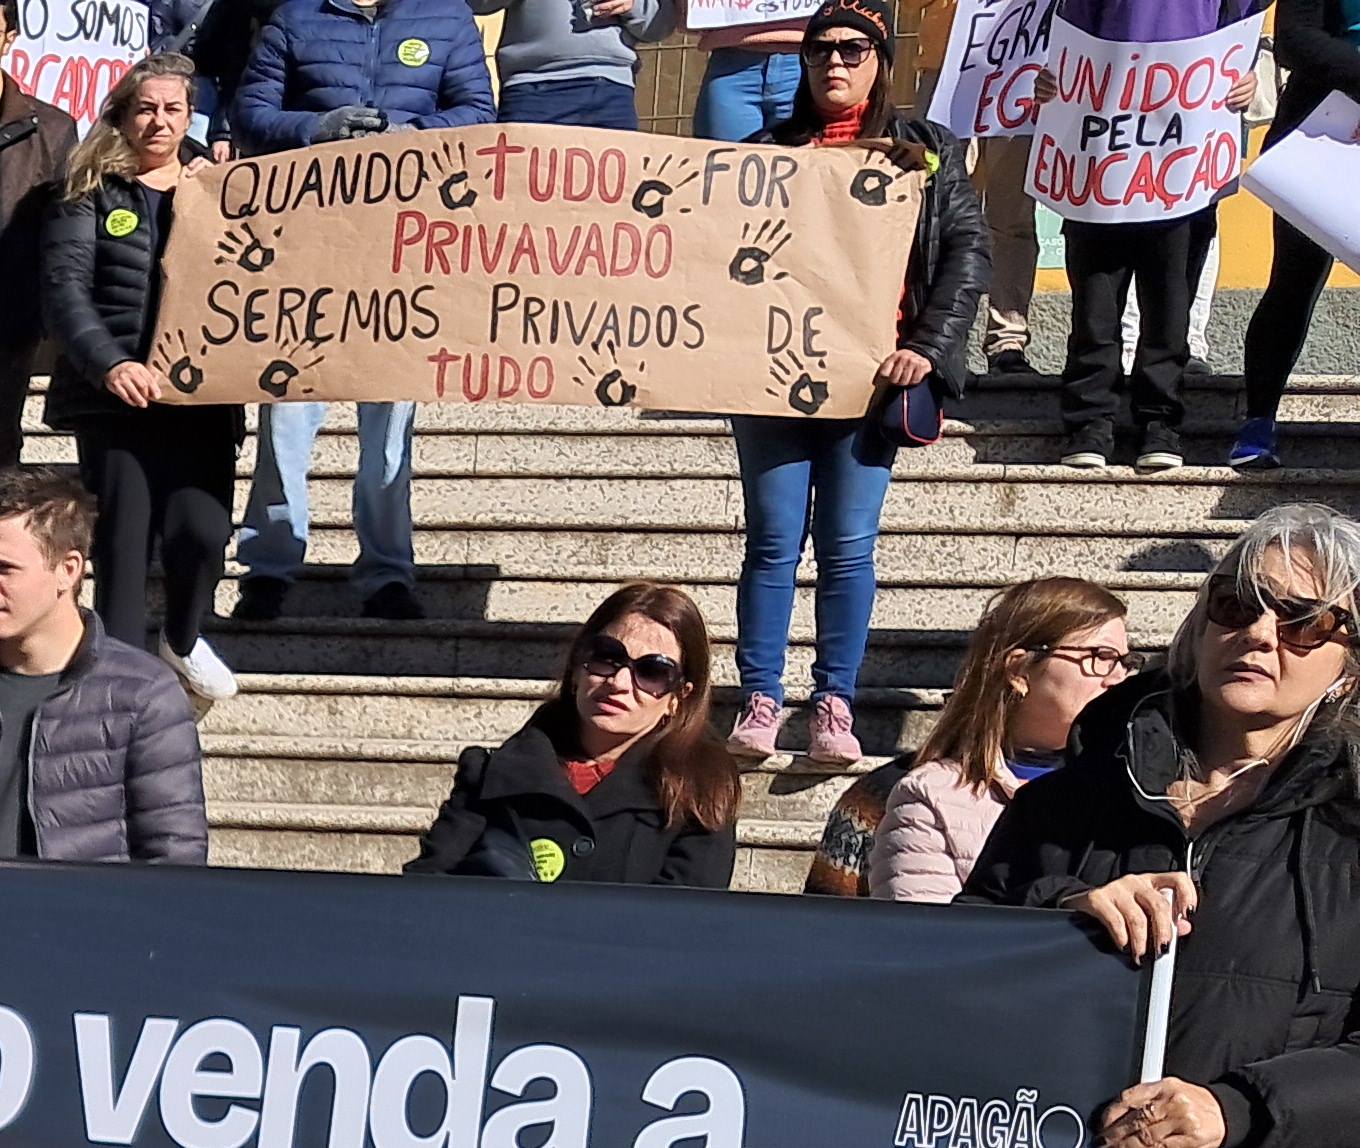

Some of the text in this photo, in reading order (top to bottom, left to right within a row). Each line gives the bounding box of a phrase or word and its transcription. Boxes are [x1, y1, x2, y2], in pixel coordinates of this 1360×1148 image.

[56, 0, 146, 51] SOMOS
[1080, 113, 1182, 152] PELA
[220, 131, 799, 220] QUANDO TUDO FOR
[1034, 129, 1237, 211] EDUCAÇÃO
[391, 210, 673, 279] PRIVAVADO
[201, 279, 828, 358] SEREMOS PRIVADOS DE
[427, 347, 555, 401] TUDO
